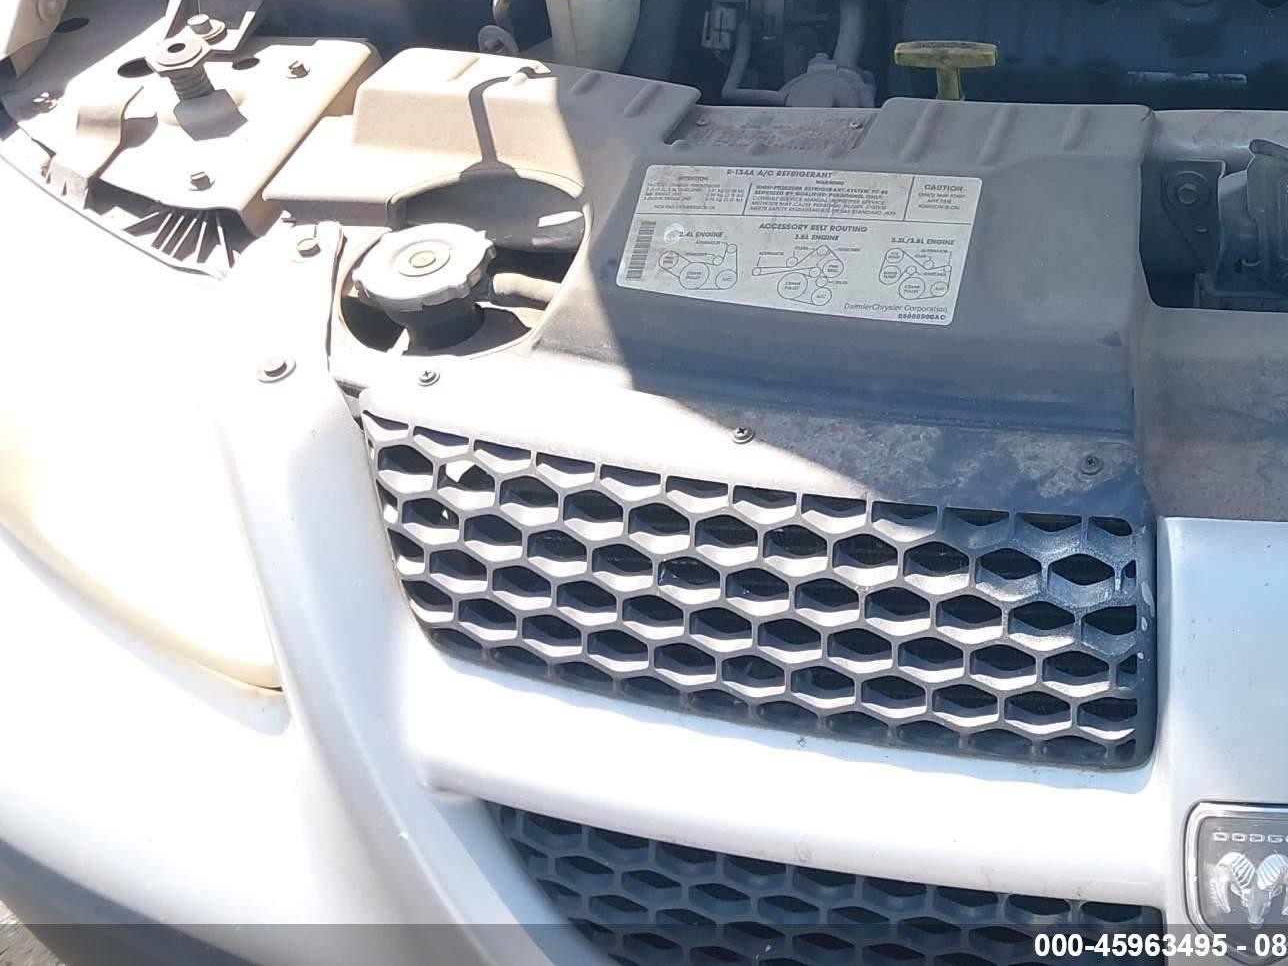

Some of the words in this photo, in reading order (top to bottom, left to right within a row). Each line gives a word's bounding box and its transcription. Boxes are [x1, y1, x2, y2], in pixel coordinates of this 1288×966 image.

[776, 170, 833, 179] REFRIGERANT
[924, 184, 963, 192] CAUTION
[829, 225, 868, 233] ROUTING
[811, 234, 840, 242] ENGINE
[926, 238, 956, 246] ENGINE
[904, 304, 948, 313] Corporation
